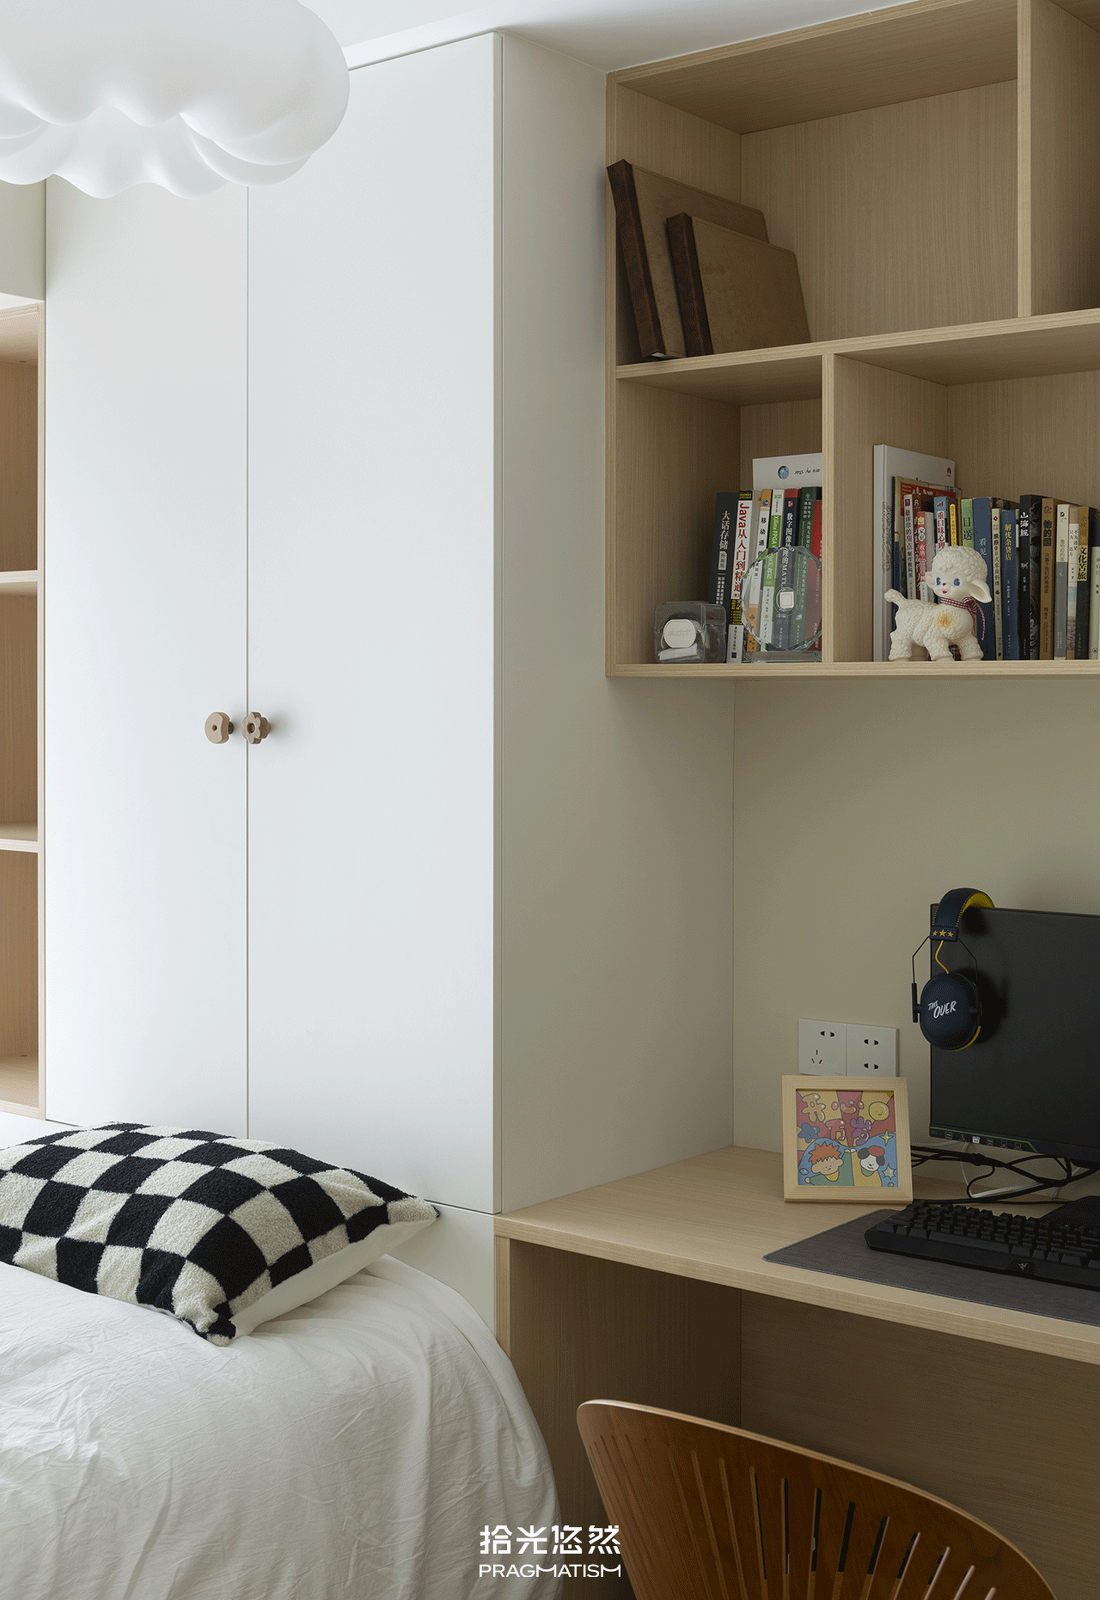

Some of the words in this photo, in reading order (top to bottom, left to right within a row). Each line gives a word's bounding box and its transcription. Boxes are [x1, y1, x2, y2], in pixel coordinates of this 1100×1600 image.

[719, 510, 731, 550] 大话存储
[733, 502, 749, 593] Java从入门到精通
[1004, 523, 1013, 561] 解忧杂货店
[1077, 546, 1088, 580] 文化苦旅
[933, 1000, 957, 1019] OVER
